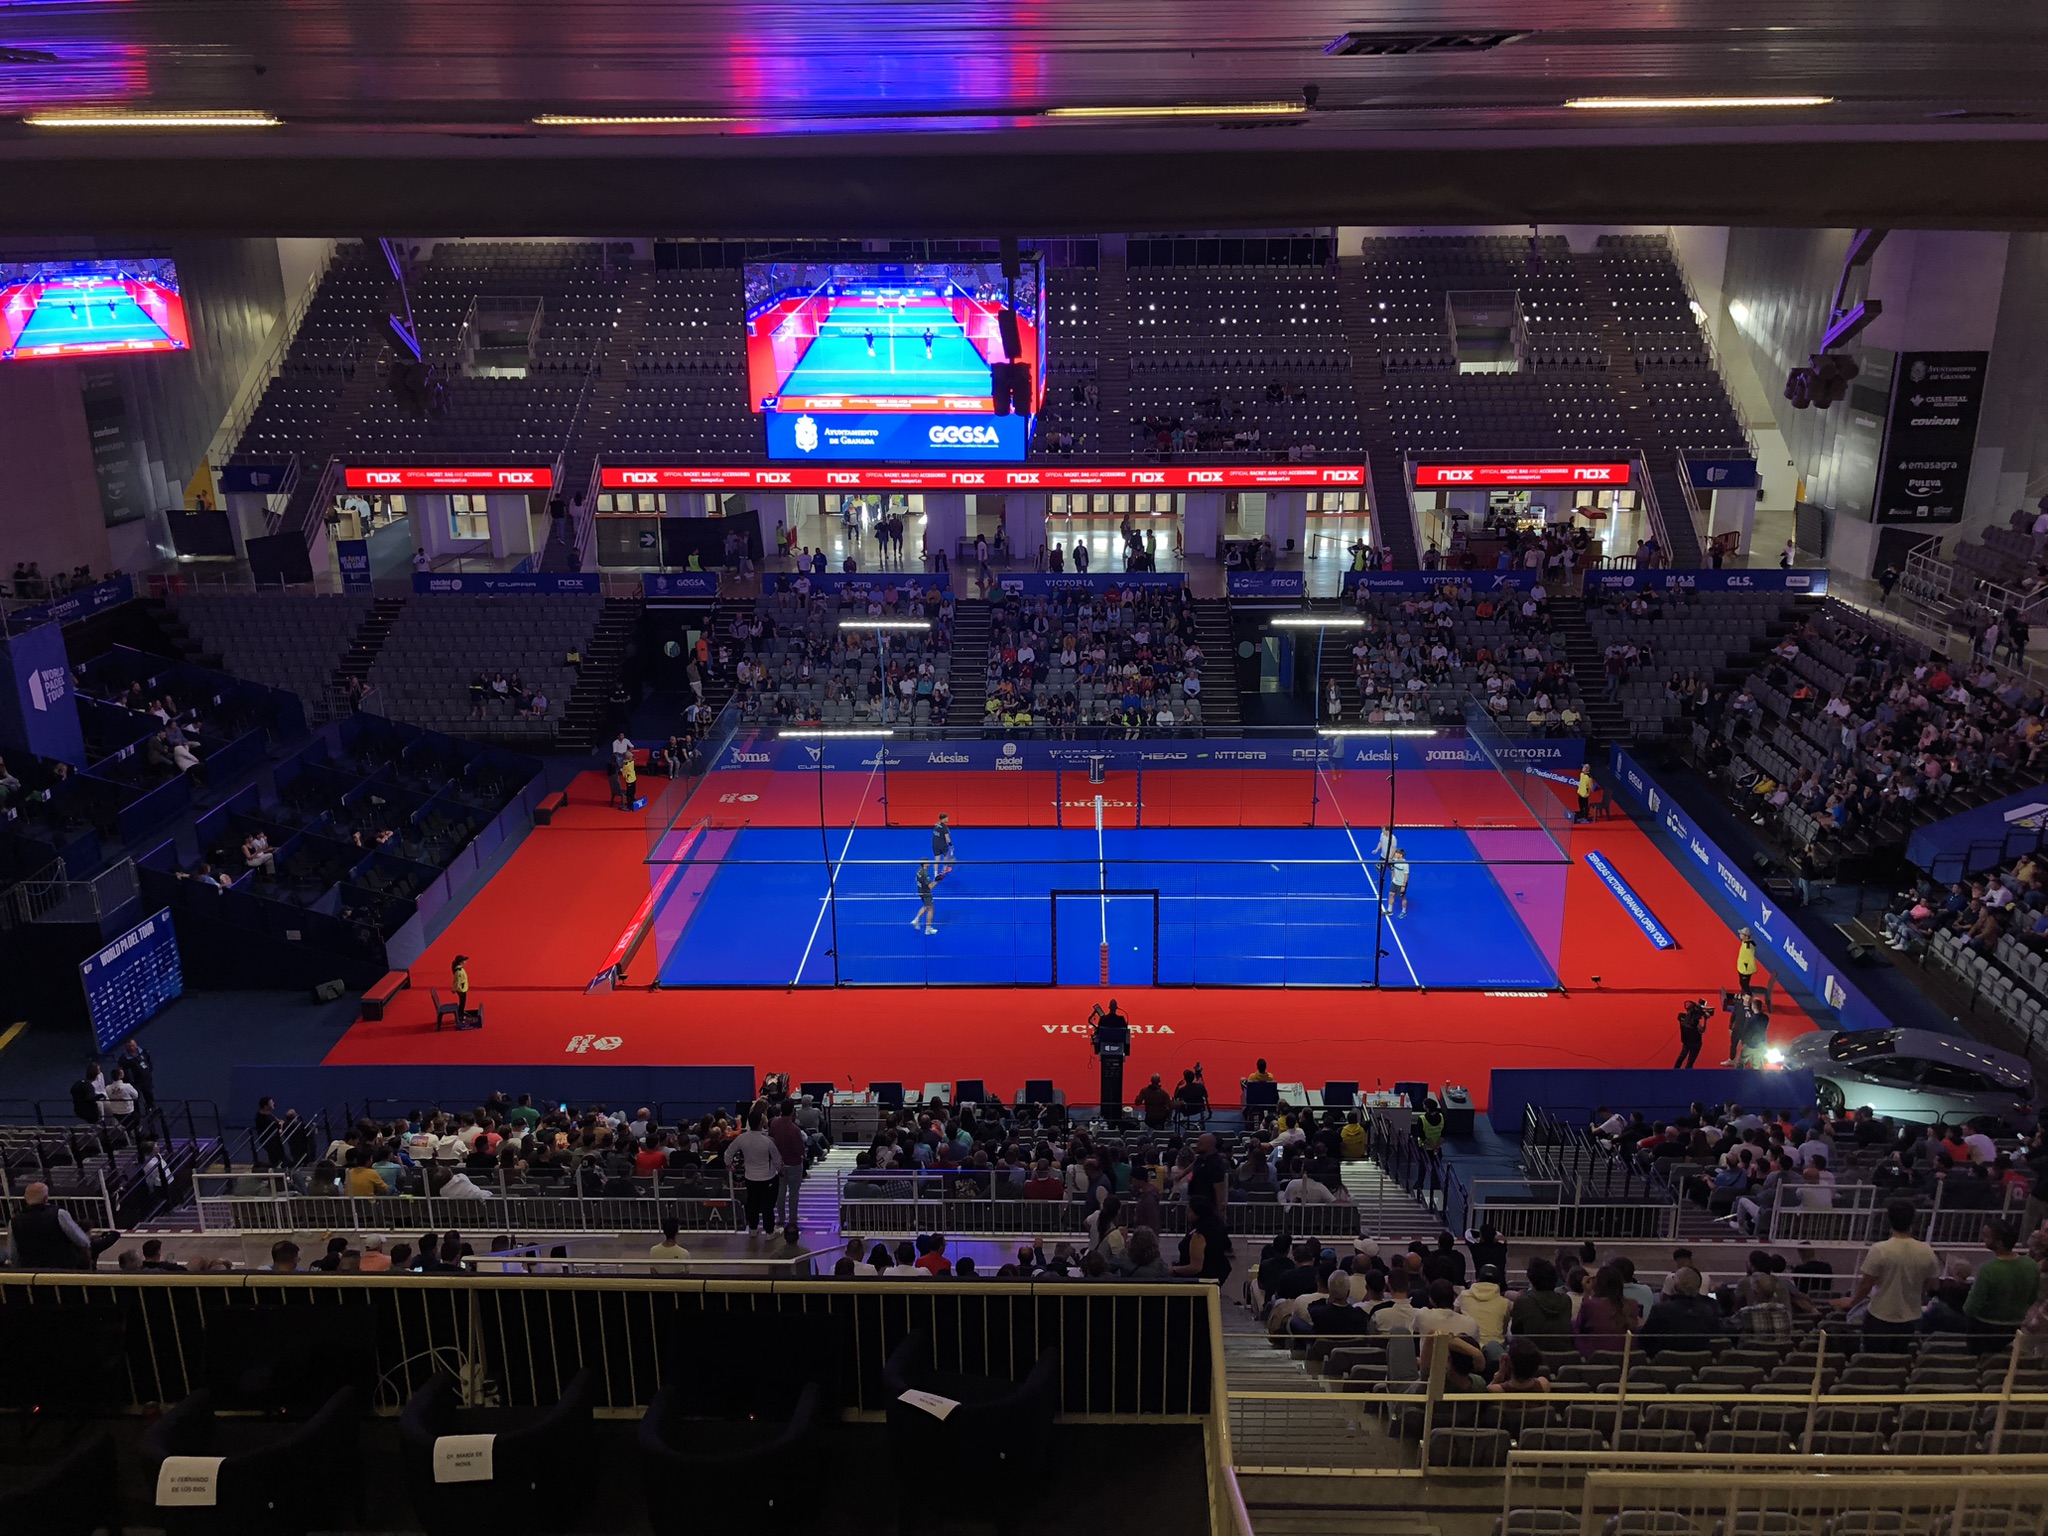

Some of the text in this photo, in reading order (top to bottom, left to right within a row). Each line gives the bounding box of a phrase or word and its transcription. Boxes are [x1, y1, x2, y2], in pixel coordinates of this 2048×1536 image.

[41, 667, 65, 681] WORLD
[44, 677, 66, 693] PADEL
[47, 687, 65, 704] TOUR
[927, 752, 970, 763] Adeslas
[1141, 752, 1188, 760] HEAD
[1214, 751, 1237, 760] NTT
[1356, 750, 1399, 761] Adeslas
[1495, 748, 1562, 758] VICTORIA
[1717, 861, 1747, 902] VICTORIA
[1587, 852, 1668, 947] CERVEZAS VICTORIA GRANADA OPEN 1000
[99, 943, 121, 967] WORLD
[139, 921, 155, 941] TOUR
[1783, 936, 1809, 972] Adeslas
[1041, 1024, 1175, 1034] VICRIA
[709, 1206, 723, 1221] A
